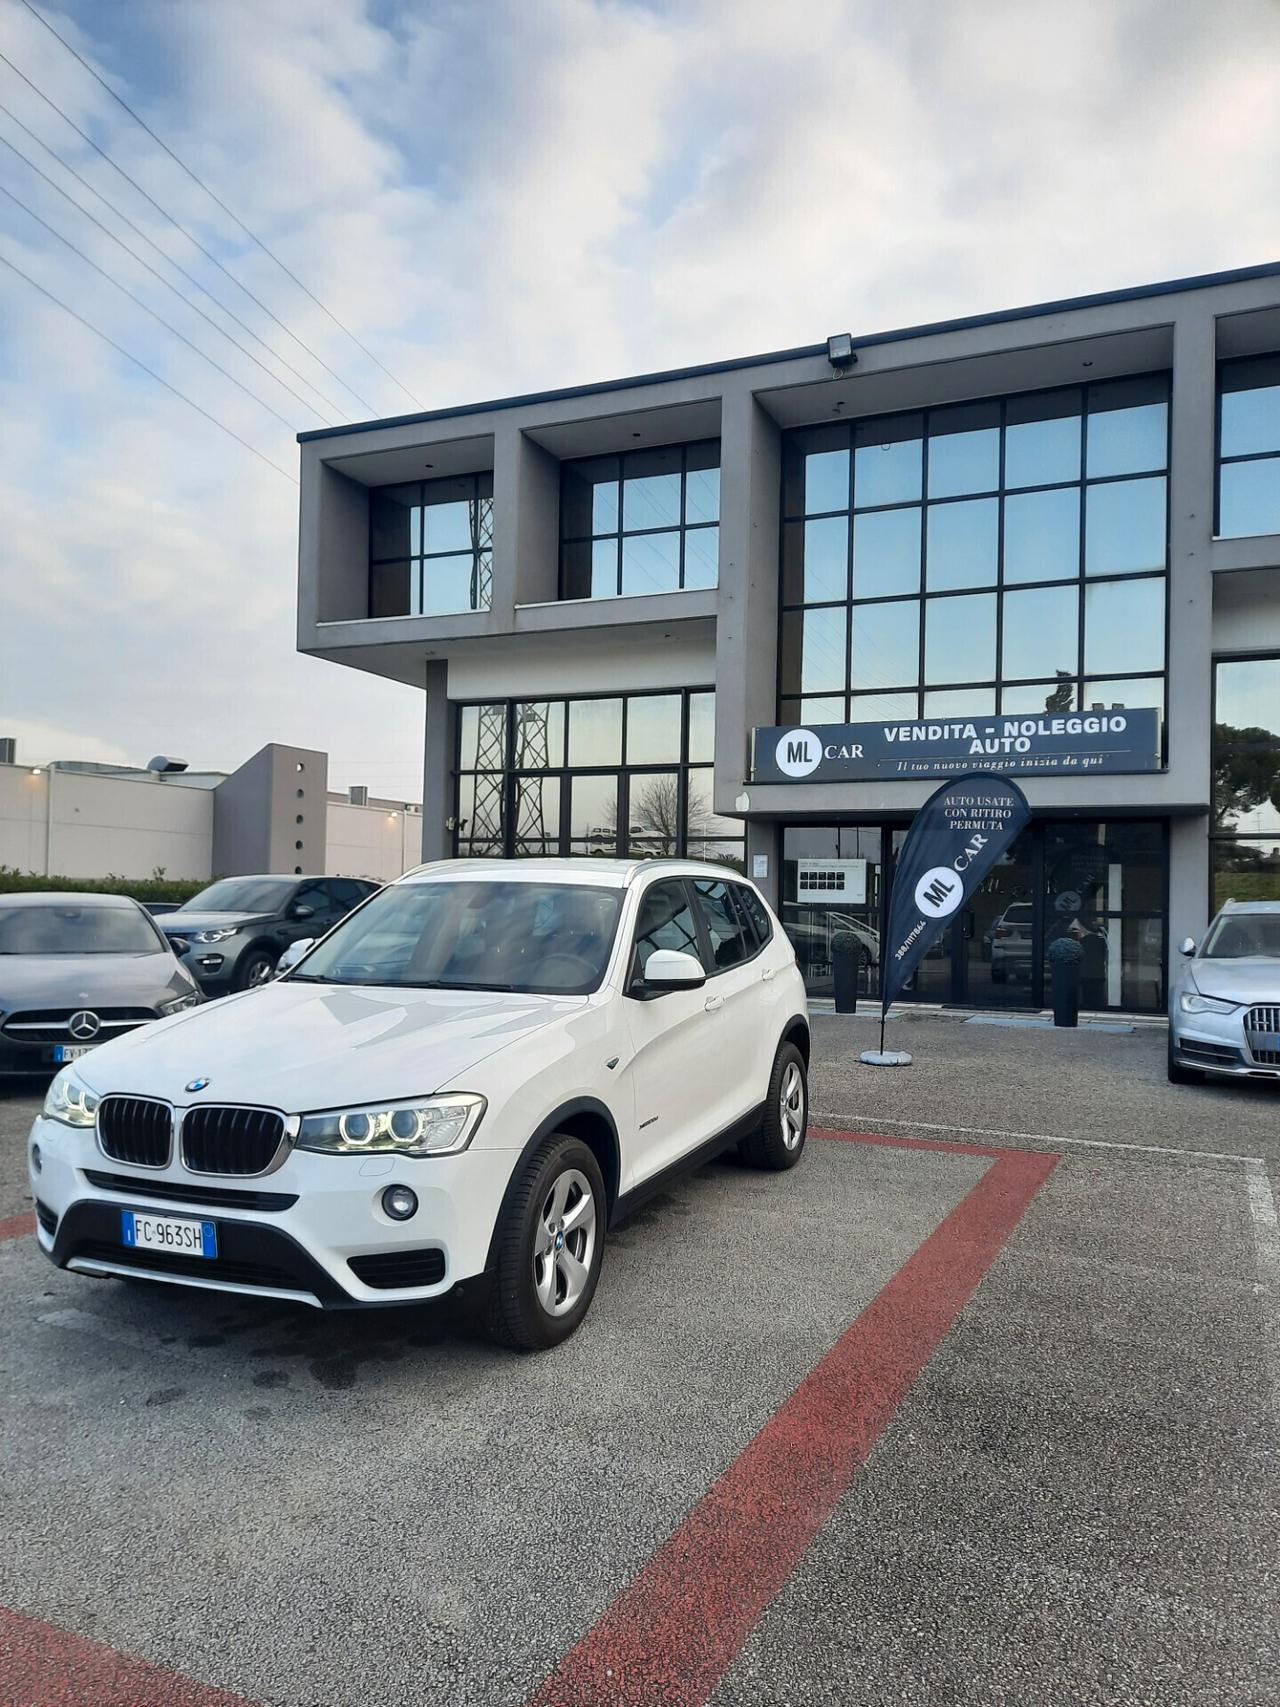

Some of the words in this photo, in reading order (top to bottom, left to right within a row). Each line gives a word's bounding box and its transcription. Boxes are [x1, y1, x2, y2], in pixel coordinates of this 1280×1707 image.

[884, 723, 978, 743] VENDITA
[1003, 715, 1128, 738] NOLEGGIO
[786, 741, 813, 763] ML
[823, 744, 864, 760] CAR
[968, 737, 1031, 755] AUTO
[896, 761, 908, 772] Il
[911, 761, 930, 771] tuo
[933, 760, 968, 770] nuovo
[972, 758, 1016, 771] viaggio
[1020, 756, 1058, 768] inizia
[1062, 755, 1078, 766] da
[1082, 754, 1104, 768] qui
[943, 796, 975, 806] AUTO
[977, 796, 1014, 807] USATE
[944, 808, 968, 818] CON
[970, 808, 1012, 819] RITIRO
[950, 820, 1003, 831] PERMUTA
[922, 878, 956, 909] ML
[953, 833, 989, 872] CAR
[135, 1219, 152, 1242] FC
[156, 1223, 202, 1249] 963SH
